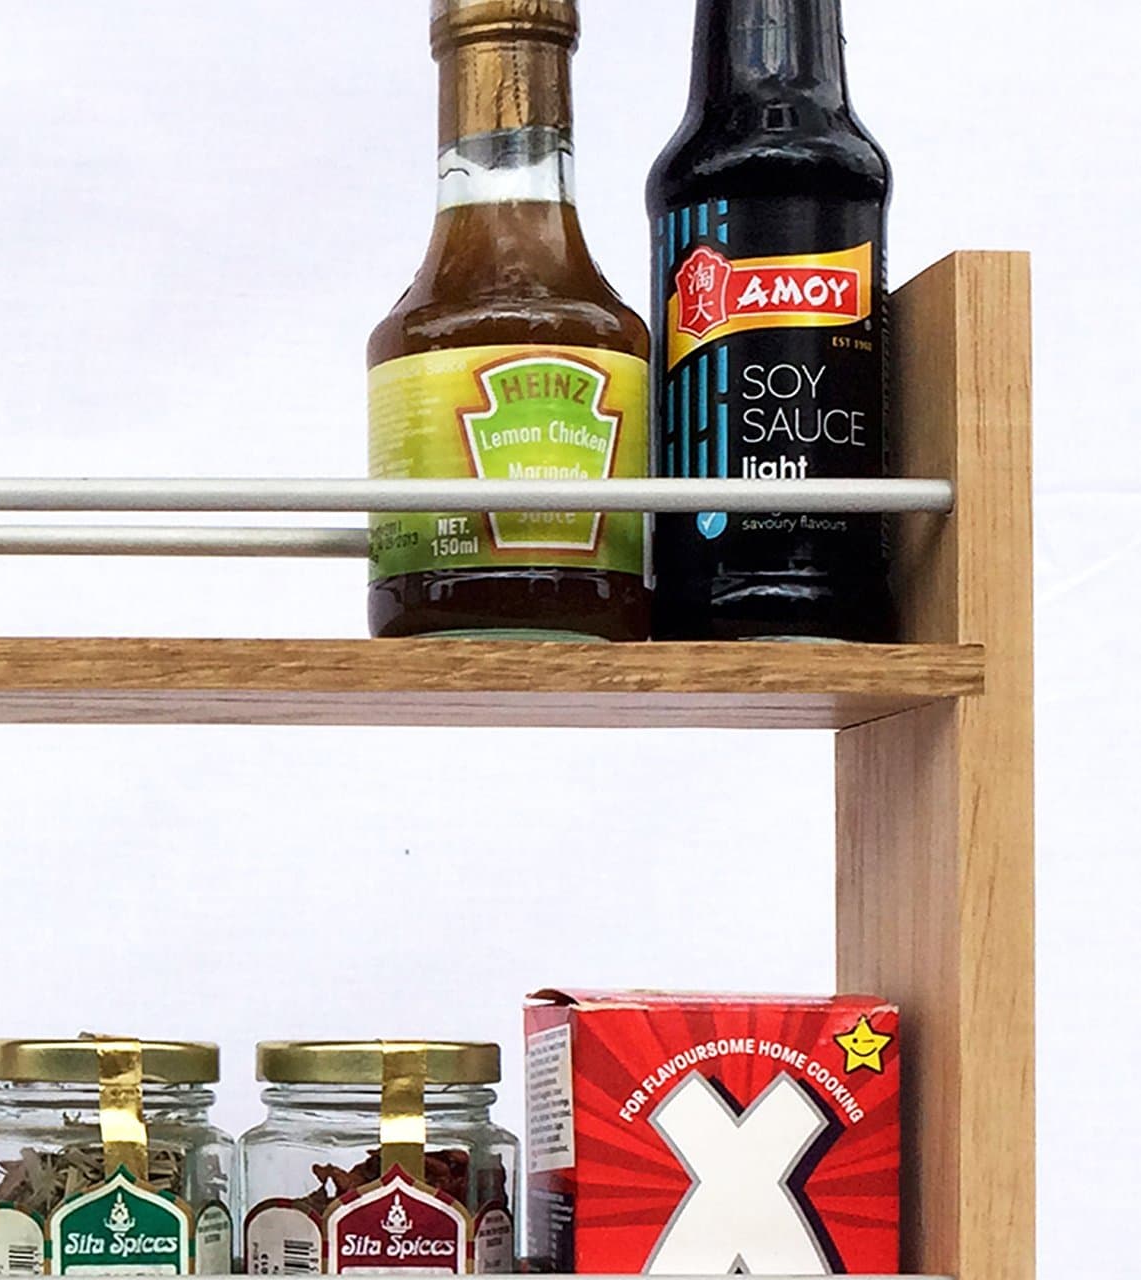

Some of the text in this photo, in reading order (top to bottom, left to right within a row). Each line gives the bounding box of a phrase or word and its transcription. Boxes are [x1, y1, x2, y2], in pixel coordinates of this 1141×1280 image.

[737, 274, 849, 311] AMOY
[501, 372, 590, 405] HEINZ
[742, 364, 826, 400] SOY
[480, 420, 607, 452] Lemon Chicken
[742, 407, 865, 446] SAUCE
[742, 455, 808, 479] light
[438, 517, 470, 535] NET.
[742, 515, 848, 533] savoury flavours
[430, 536, 479, 556] 150ml
[619, 1038, 865, 1123] FOR FLAVOURSOME HOME COOKING
[64, 1232, 178, 1257] Sita Spices
[341, 1234, 455, 1259] Sita Spices
